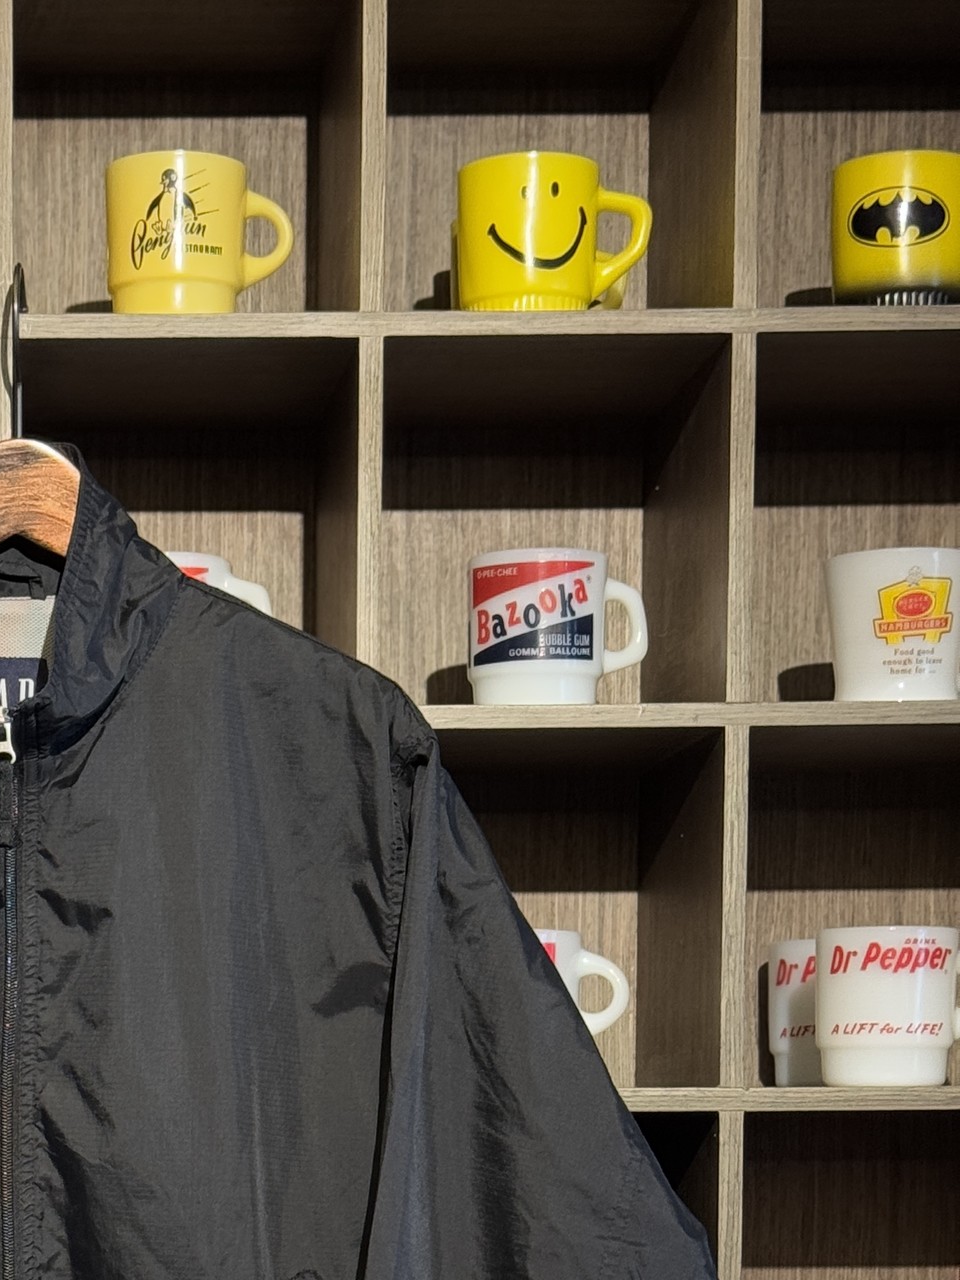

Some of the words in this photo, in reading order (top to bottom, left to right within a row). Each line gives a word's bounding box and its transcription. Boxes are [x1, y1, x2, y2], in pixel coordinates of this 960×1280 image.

[477, 578, 589, 645] Bazooka
[880, 618, 946, 632] HAMBURGERS
[539, 633, 572, 647] BUBBLE
[574, 633, 590, 646] GUM
[508, 647, 546, 657] GOMME
[904, 937, 937, 945] DRINK
[830, 945, 858, 975] Dr
[860, 942, 952, 974] Pepper
[775, 959, 799, 986] Dr
[831, 1024, 840, 1035] A
[843, 1022, 878, 1035] LIFT
[880, 1022, 902, 1035] for
[906, 1022, 944, 1036] LIFE!
